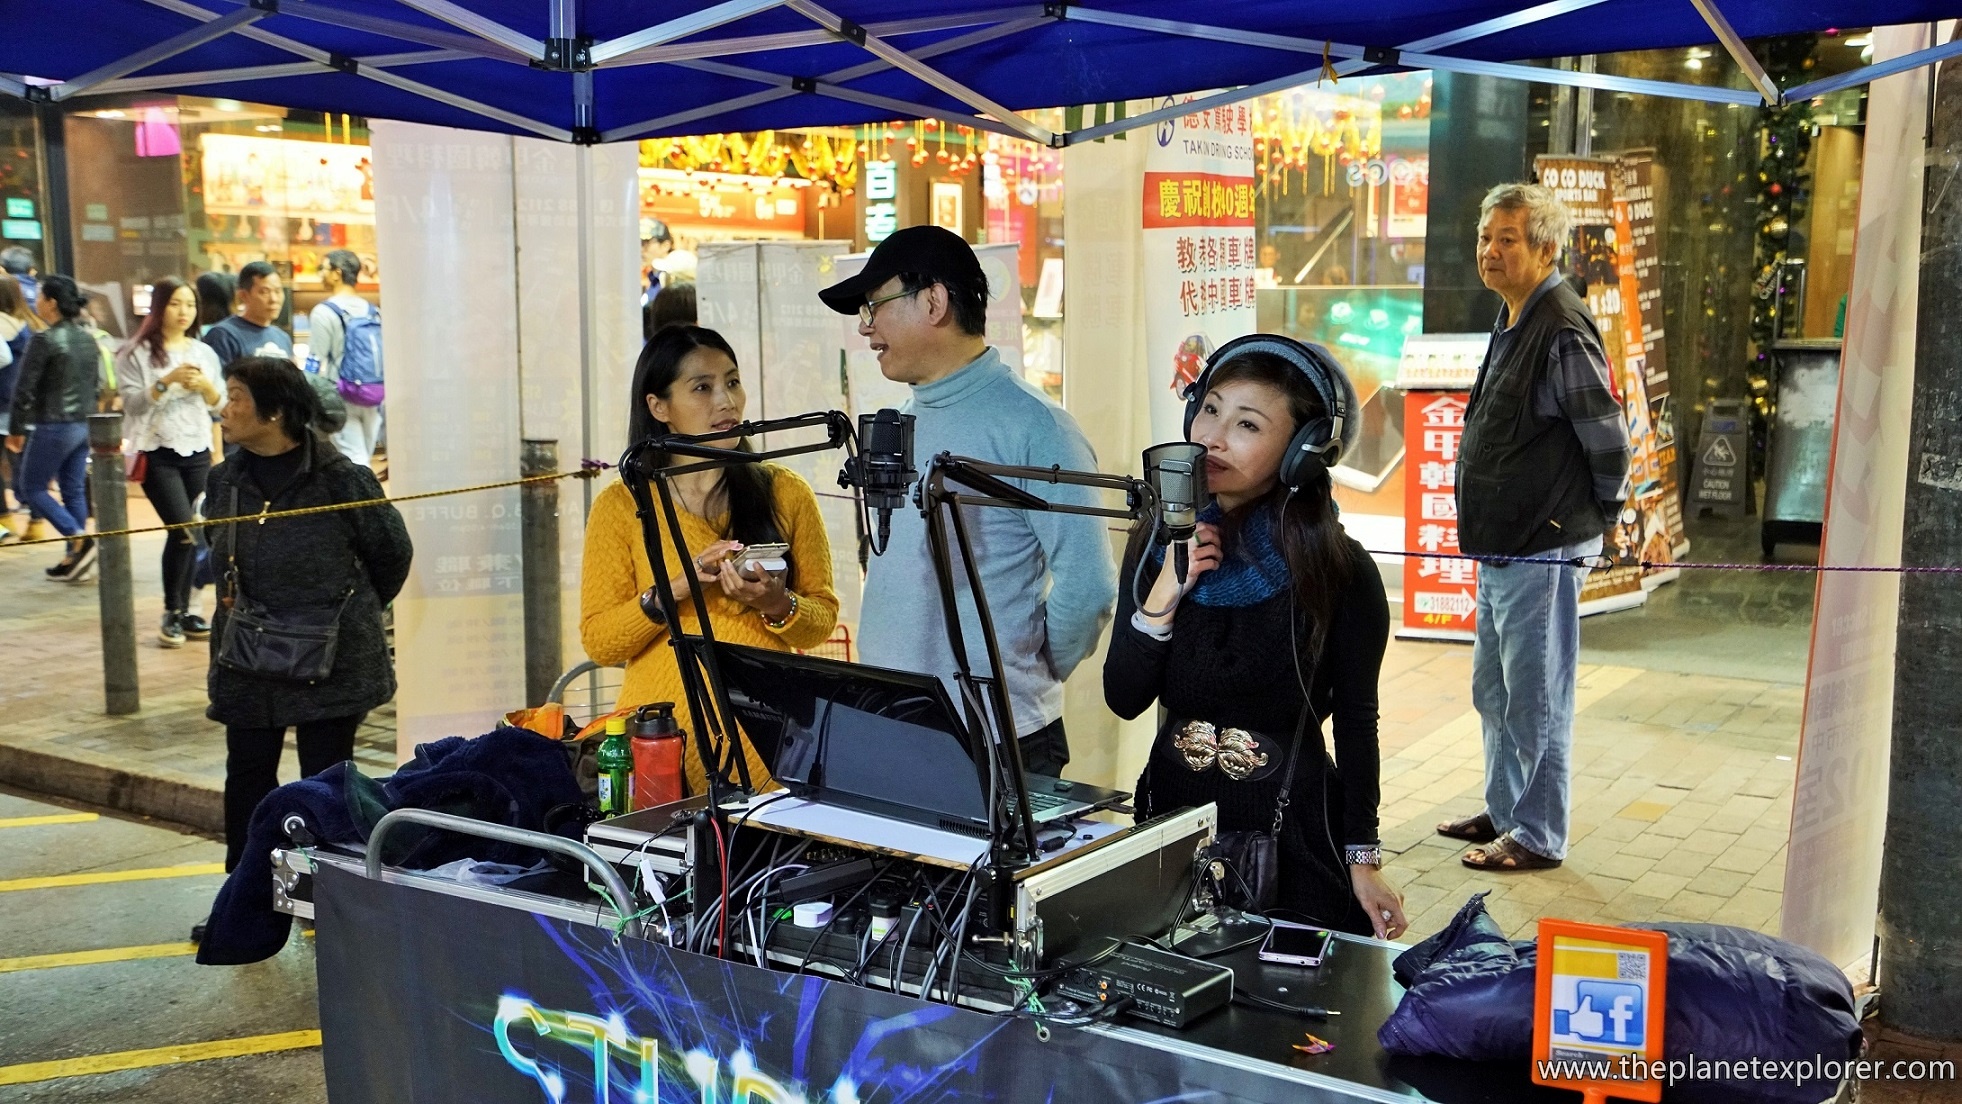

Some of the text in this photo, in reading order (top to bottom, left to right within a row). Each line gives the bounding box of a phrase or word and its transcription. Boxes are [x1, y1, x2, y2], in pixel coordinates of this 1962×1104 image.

[1578, 168, 1606, 189] DUCK
[1703, 478, 1730, 490] CAUTION
[1699, 490, 1732, 501] WET FLOOR
[1429, 594, 1470, 612] 31882112
[1424, 613, 1452, 624] 4/F
